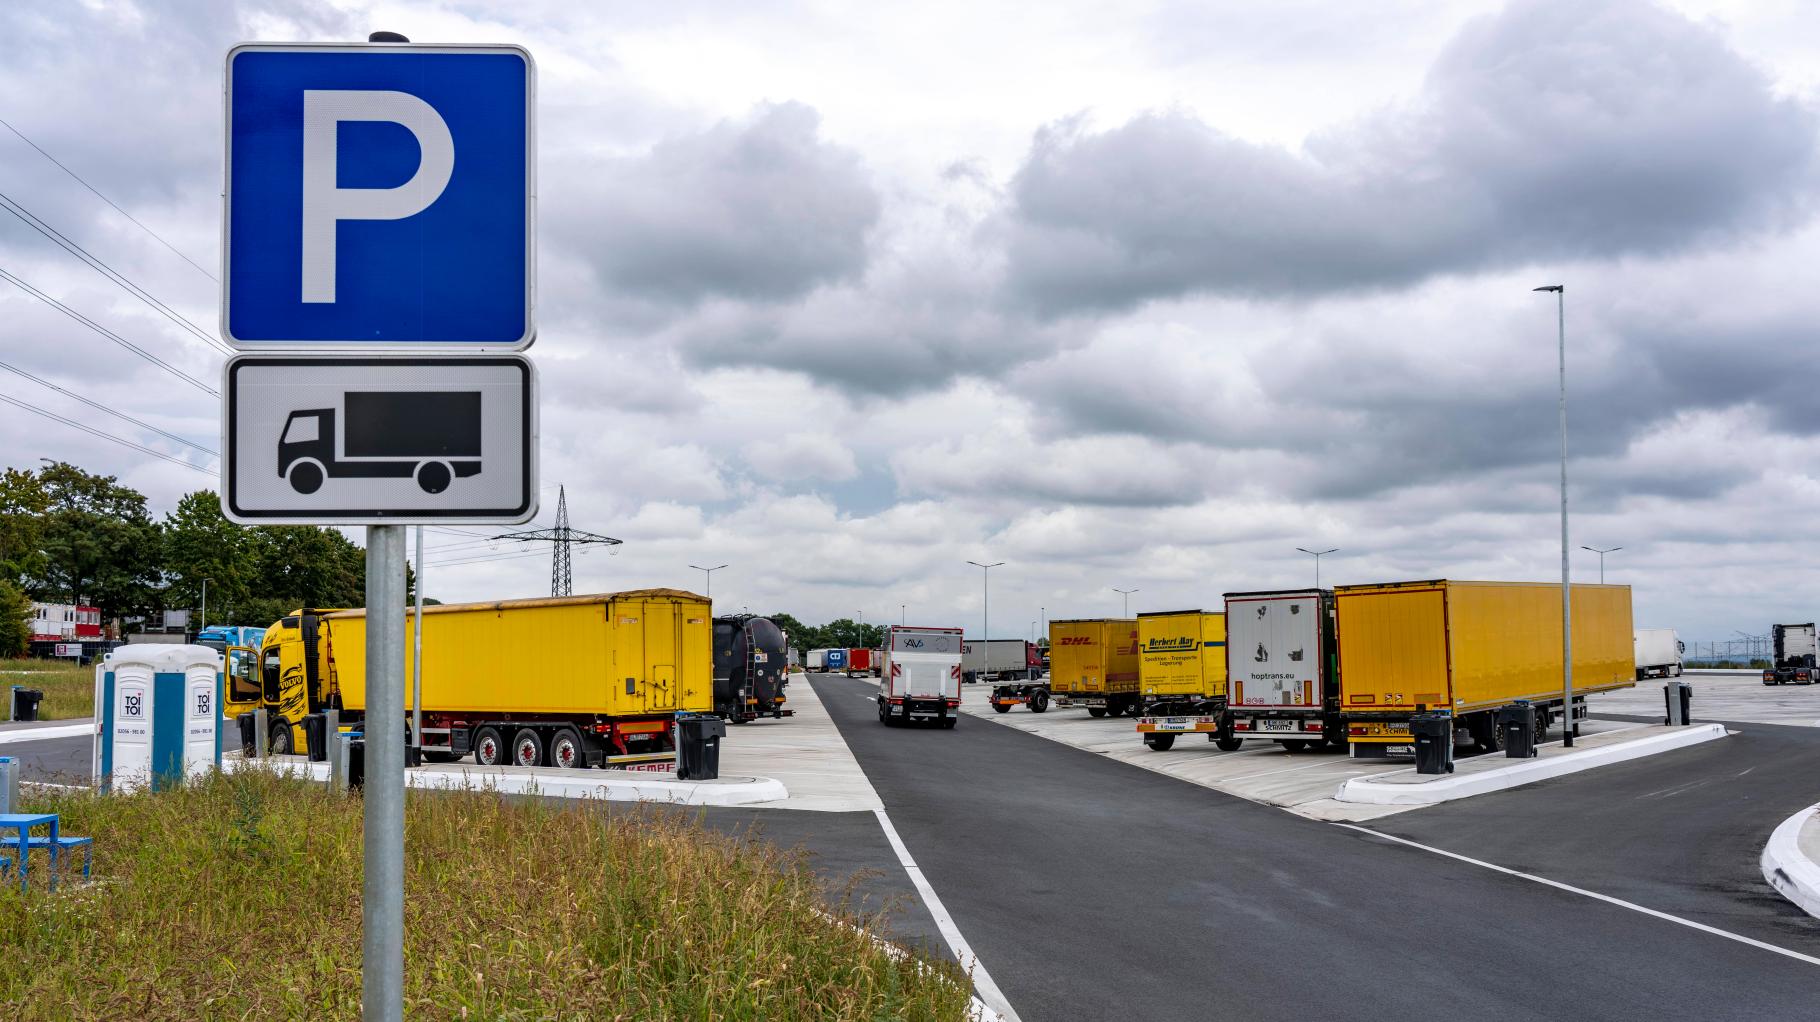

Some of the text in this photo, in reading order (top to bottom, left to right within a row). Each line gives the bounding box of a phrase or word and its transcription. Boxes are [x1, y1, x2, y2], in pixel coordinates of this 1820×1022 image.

[301, 89, 455, 304] P
[1060, 637, 1091, 645] DHL
[1150, 636, 1194, 647] Herbert May
[280, 676, 302, 689] VOLVO
[125, 706, 141, 716] TOI
[198, 704, 210, 714] TOI
